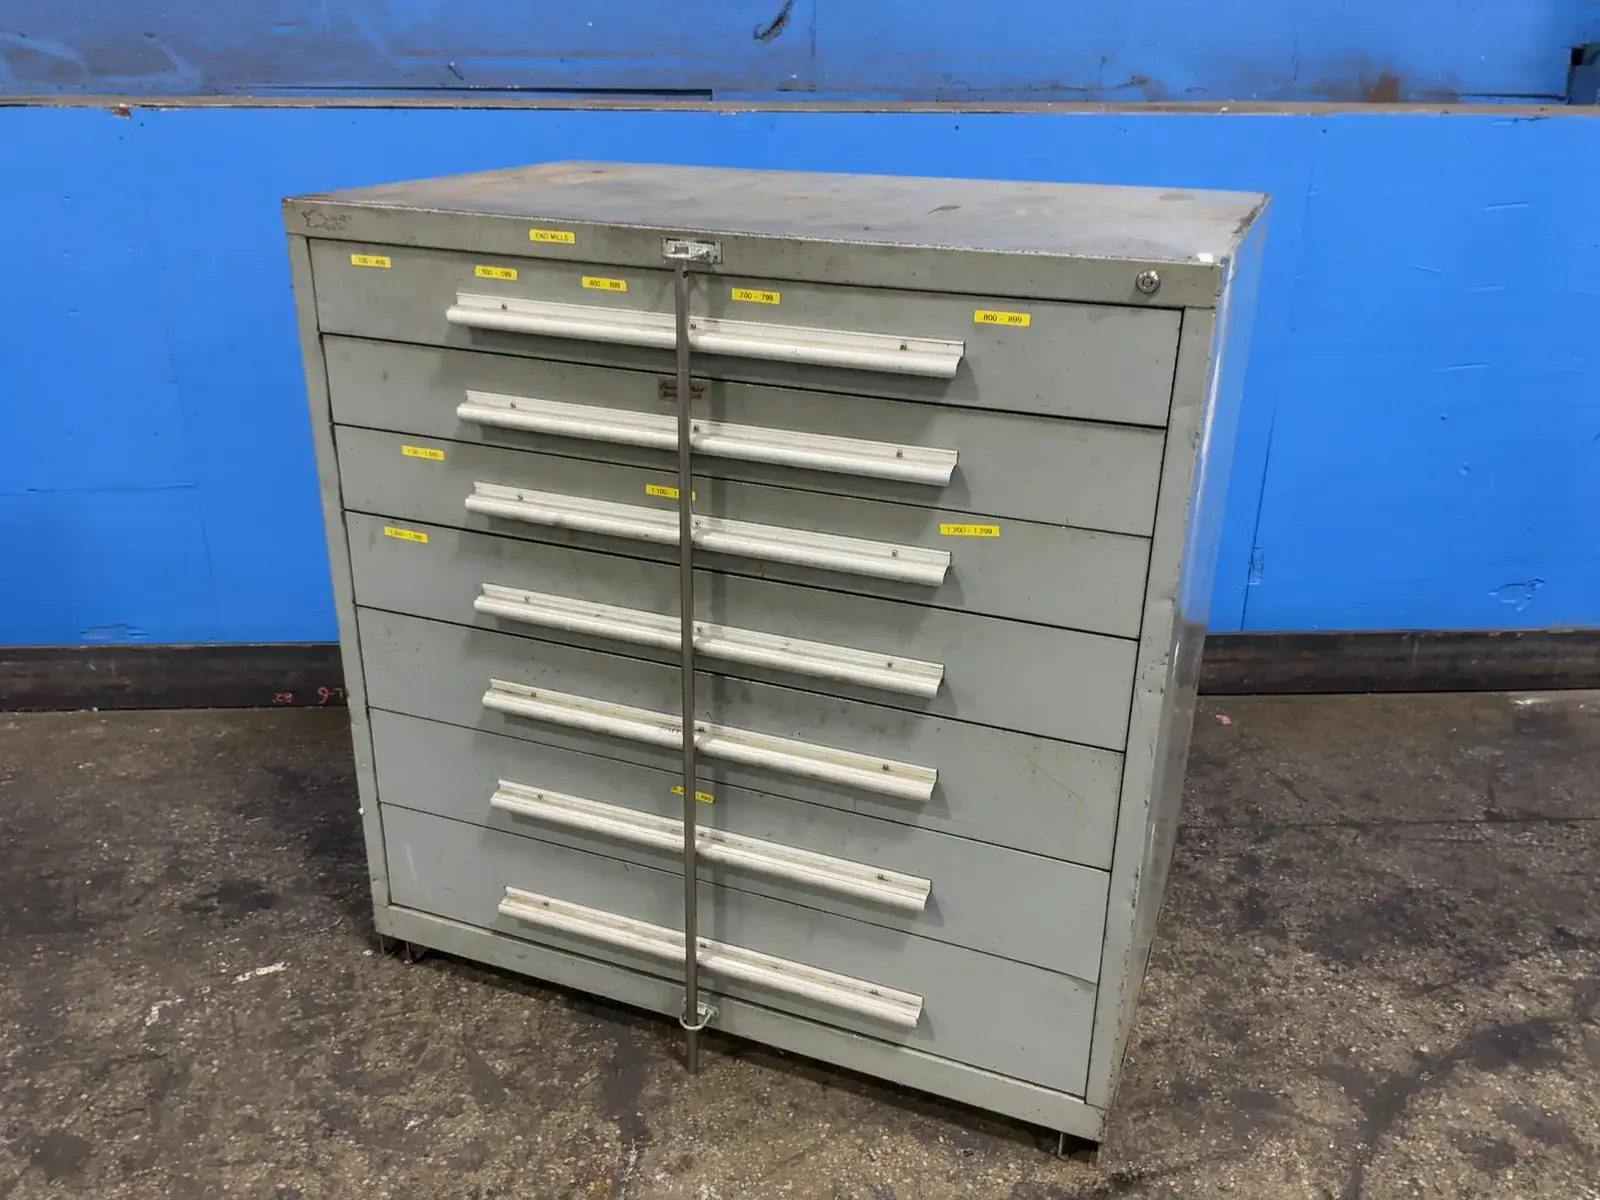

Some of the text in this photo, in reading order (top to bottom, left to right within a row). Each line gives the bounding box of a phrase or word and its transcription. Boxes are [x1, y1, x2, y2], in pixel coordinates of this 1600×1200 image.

[535, 232, 569, 241] END MILLS
[947, 526, 966, 534] 1.200
[973, 527, 993, 535] 1.299
